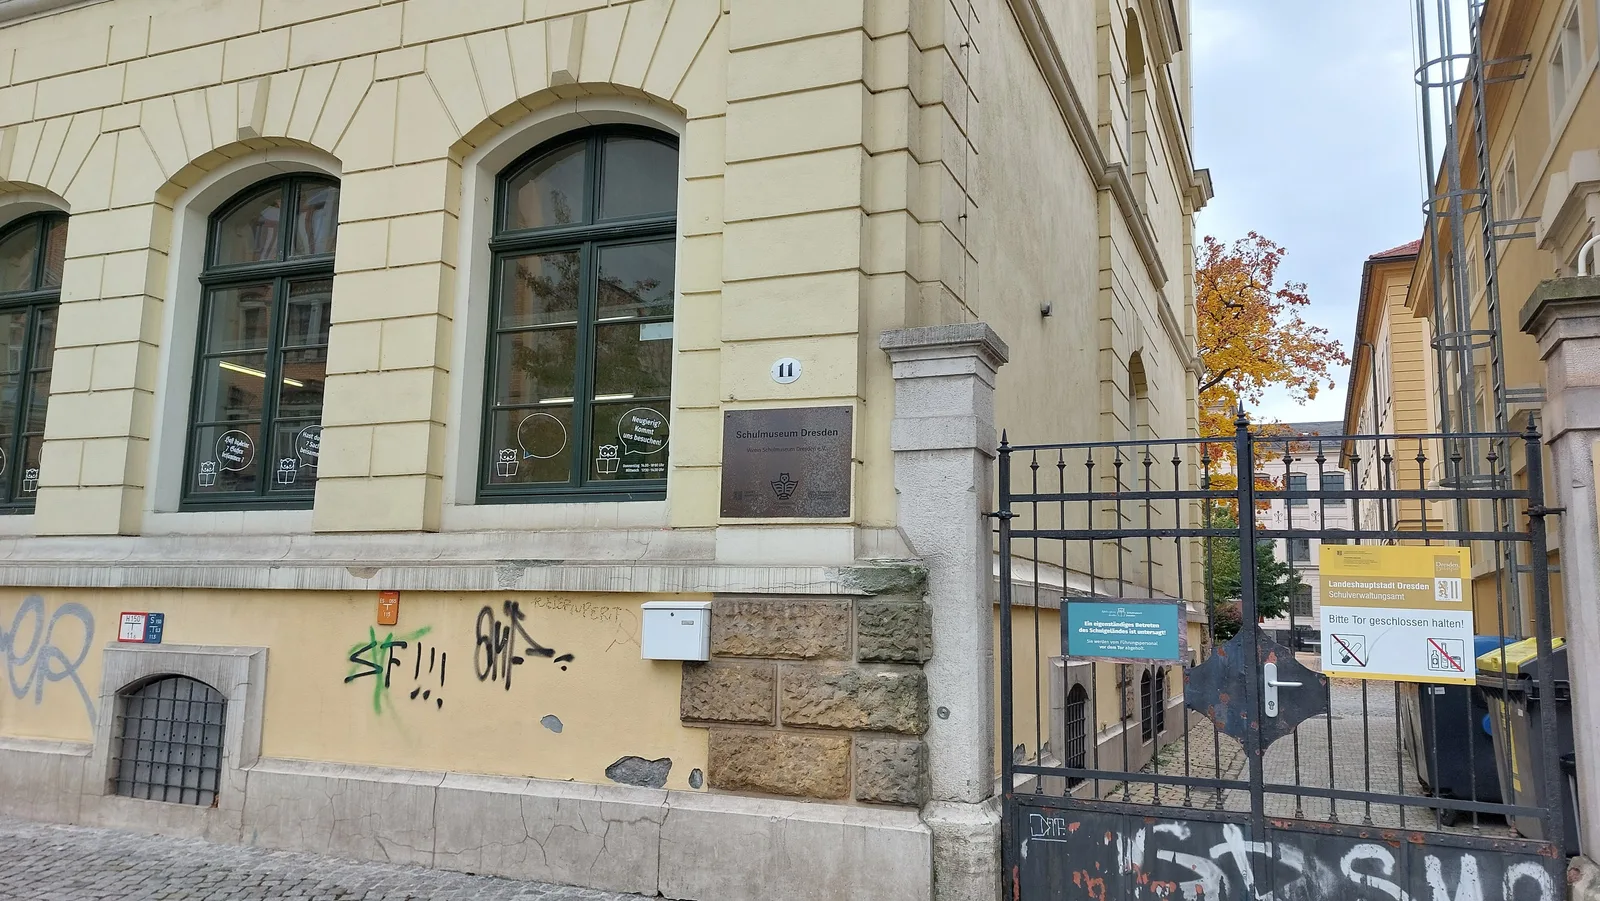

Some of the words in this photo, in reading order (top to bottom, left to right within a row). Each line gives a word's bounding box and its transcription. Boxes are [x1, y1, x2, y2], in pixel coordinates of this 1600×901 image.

[778, 362, 793, 377] 11
[632, 415, 662, 428] Neugierig?
[634, 425, 655, 435] Kommt
[736, 430, 798, 439] Schulmuseum
[801, 428, 838, 437] Dresden
[633, 434, 662, 446] besuchen!
[1328, 580, 1395, 590] Landeshauptstadt
[1397, 583, 1430, 591] Dresden
[1328, 590, 1405, 601] Schulverwaltungsamt
[1093, 620, 1135, 629] eigenständiges
[1329, 614, 1349, 625] Bitte
[1351, 615, 1366, 625] Tor
[1369, 617, 1429, 628] geschlossen
[1432, 619, 1464, 629] halten!
[1089, 627, 1129, 635] Schulgeländes
[1120, 639, 1158, 647] Führungspersonal
